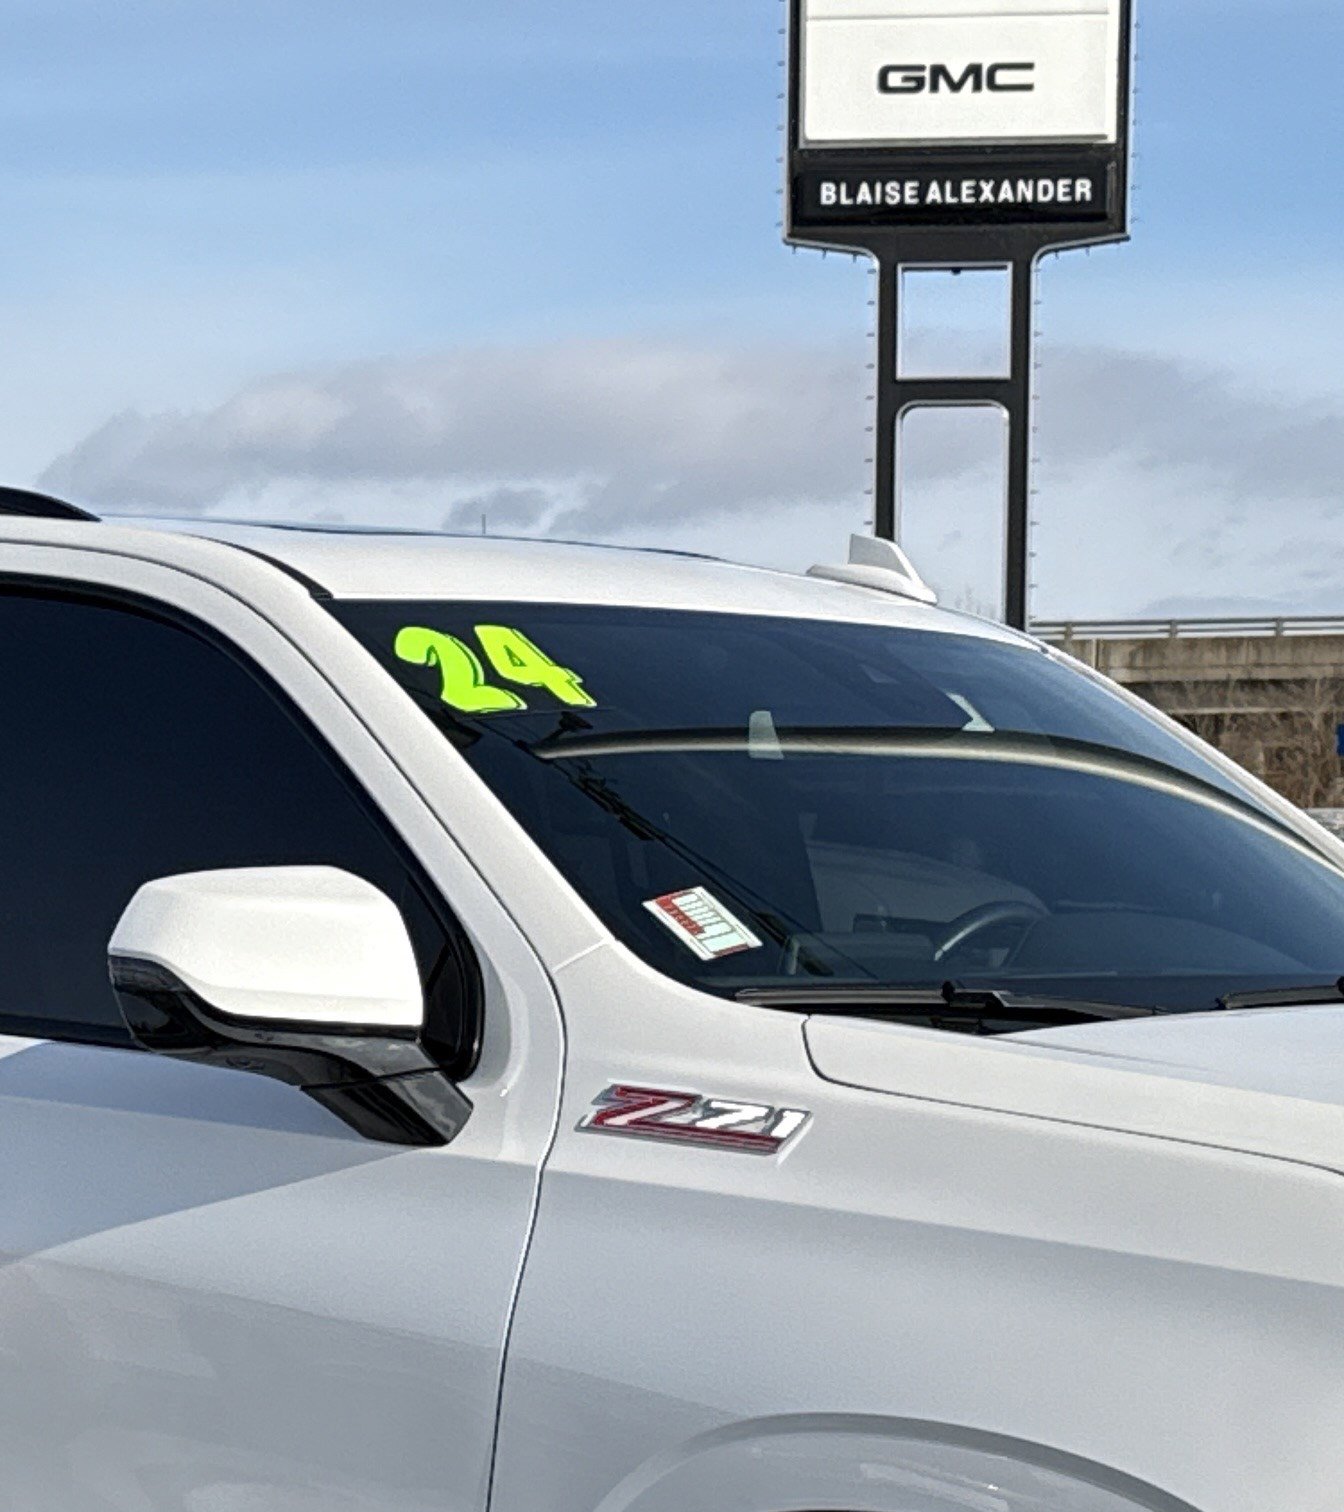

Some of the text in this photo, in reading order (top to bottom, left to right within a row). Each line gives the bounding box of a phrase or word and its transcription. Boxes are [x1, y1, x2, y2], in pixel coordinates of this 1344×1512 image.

[877, 62, 1035, 94] GMC
[820, 178, 1093, 206] BLAISE ALEXANDER
[394, 625, 597, 713] 24
[575, 1083, 812, 1156] Z71
